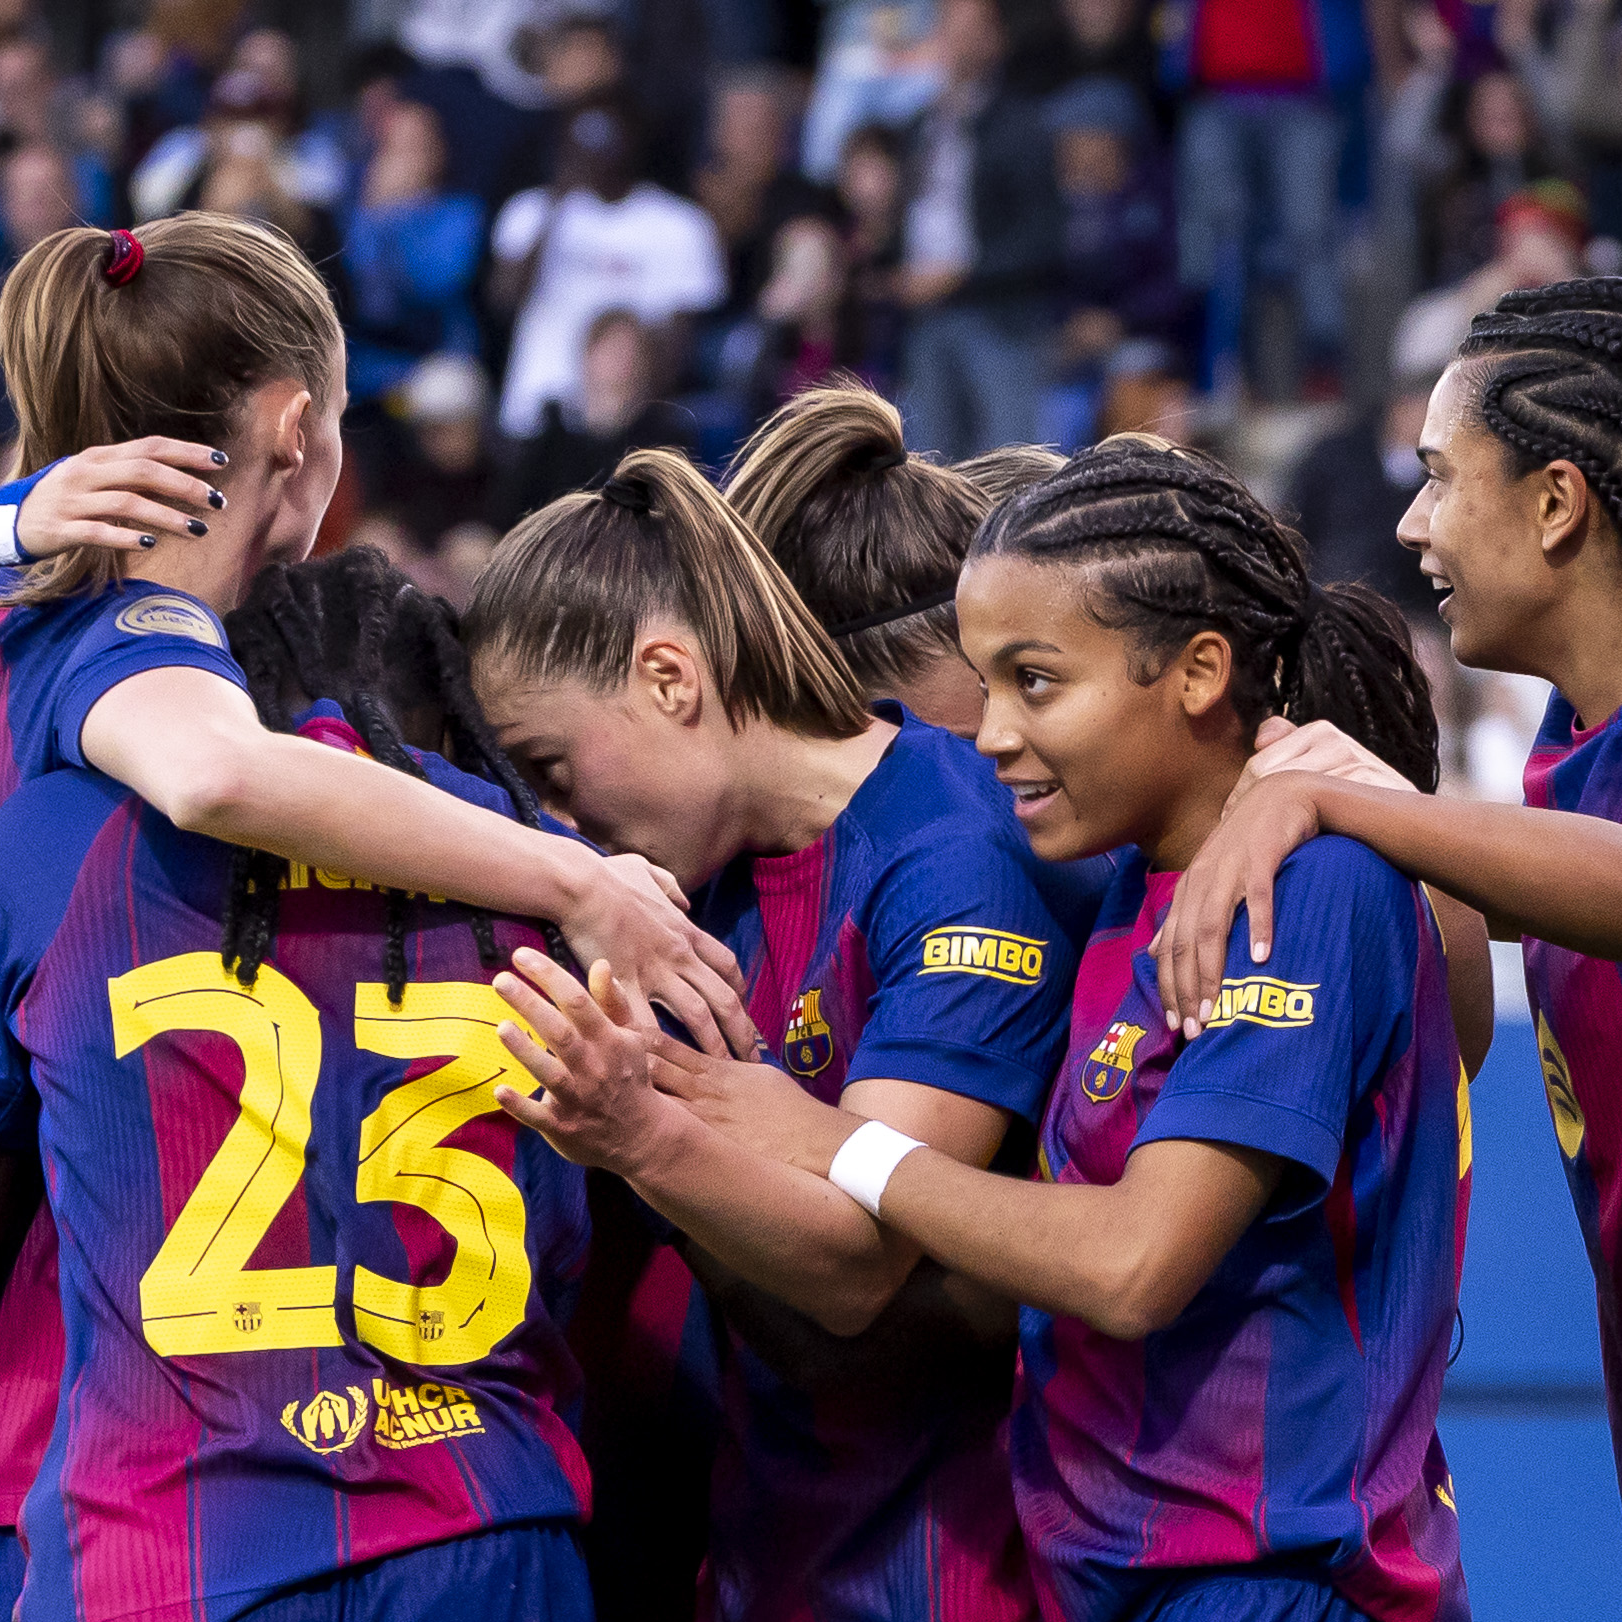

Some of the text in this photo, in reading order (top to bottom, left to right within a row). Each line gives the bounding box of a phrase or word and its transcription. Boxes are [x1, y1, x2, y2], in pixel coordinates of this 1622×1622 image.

[923, 935, 1043, 978] BIMBO
[108, 951, 545, 1365] 23
[372, 1378, 471, 1416] UHCR
